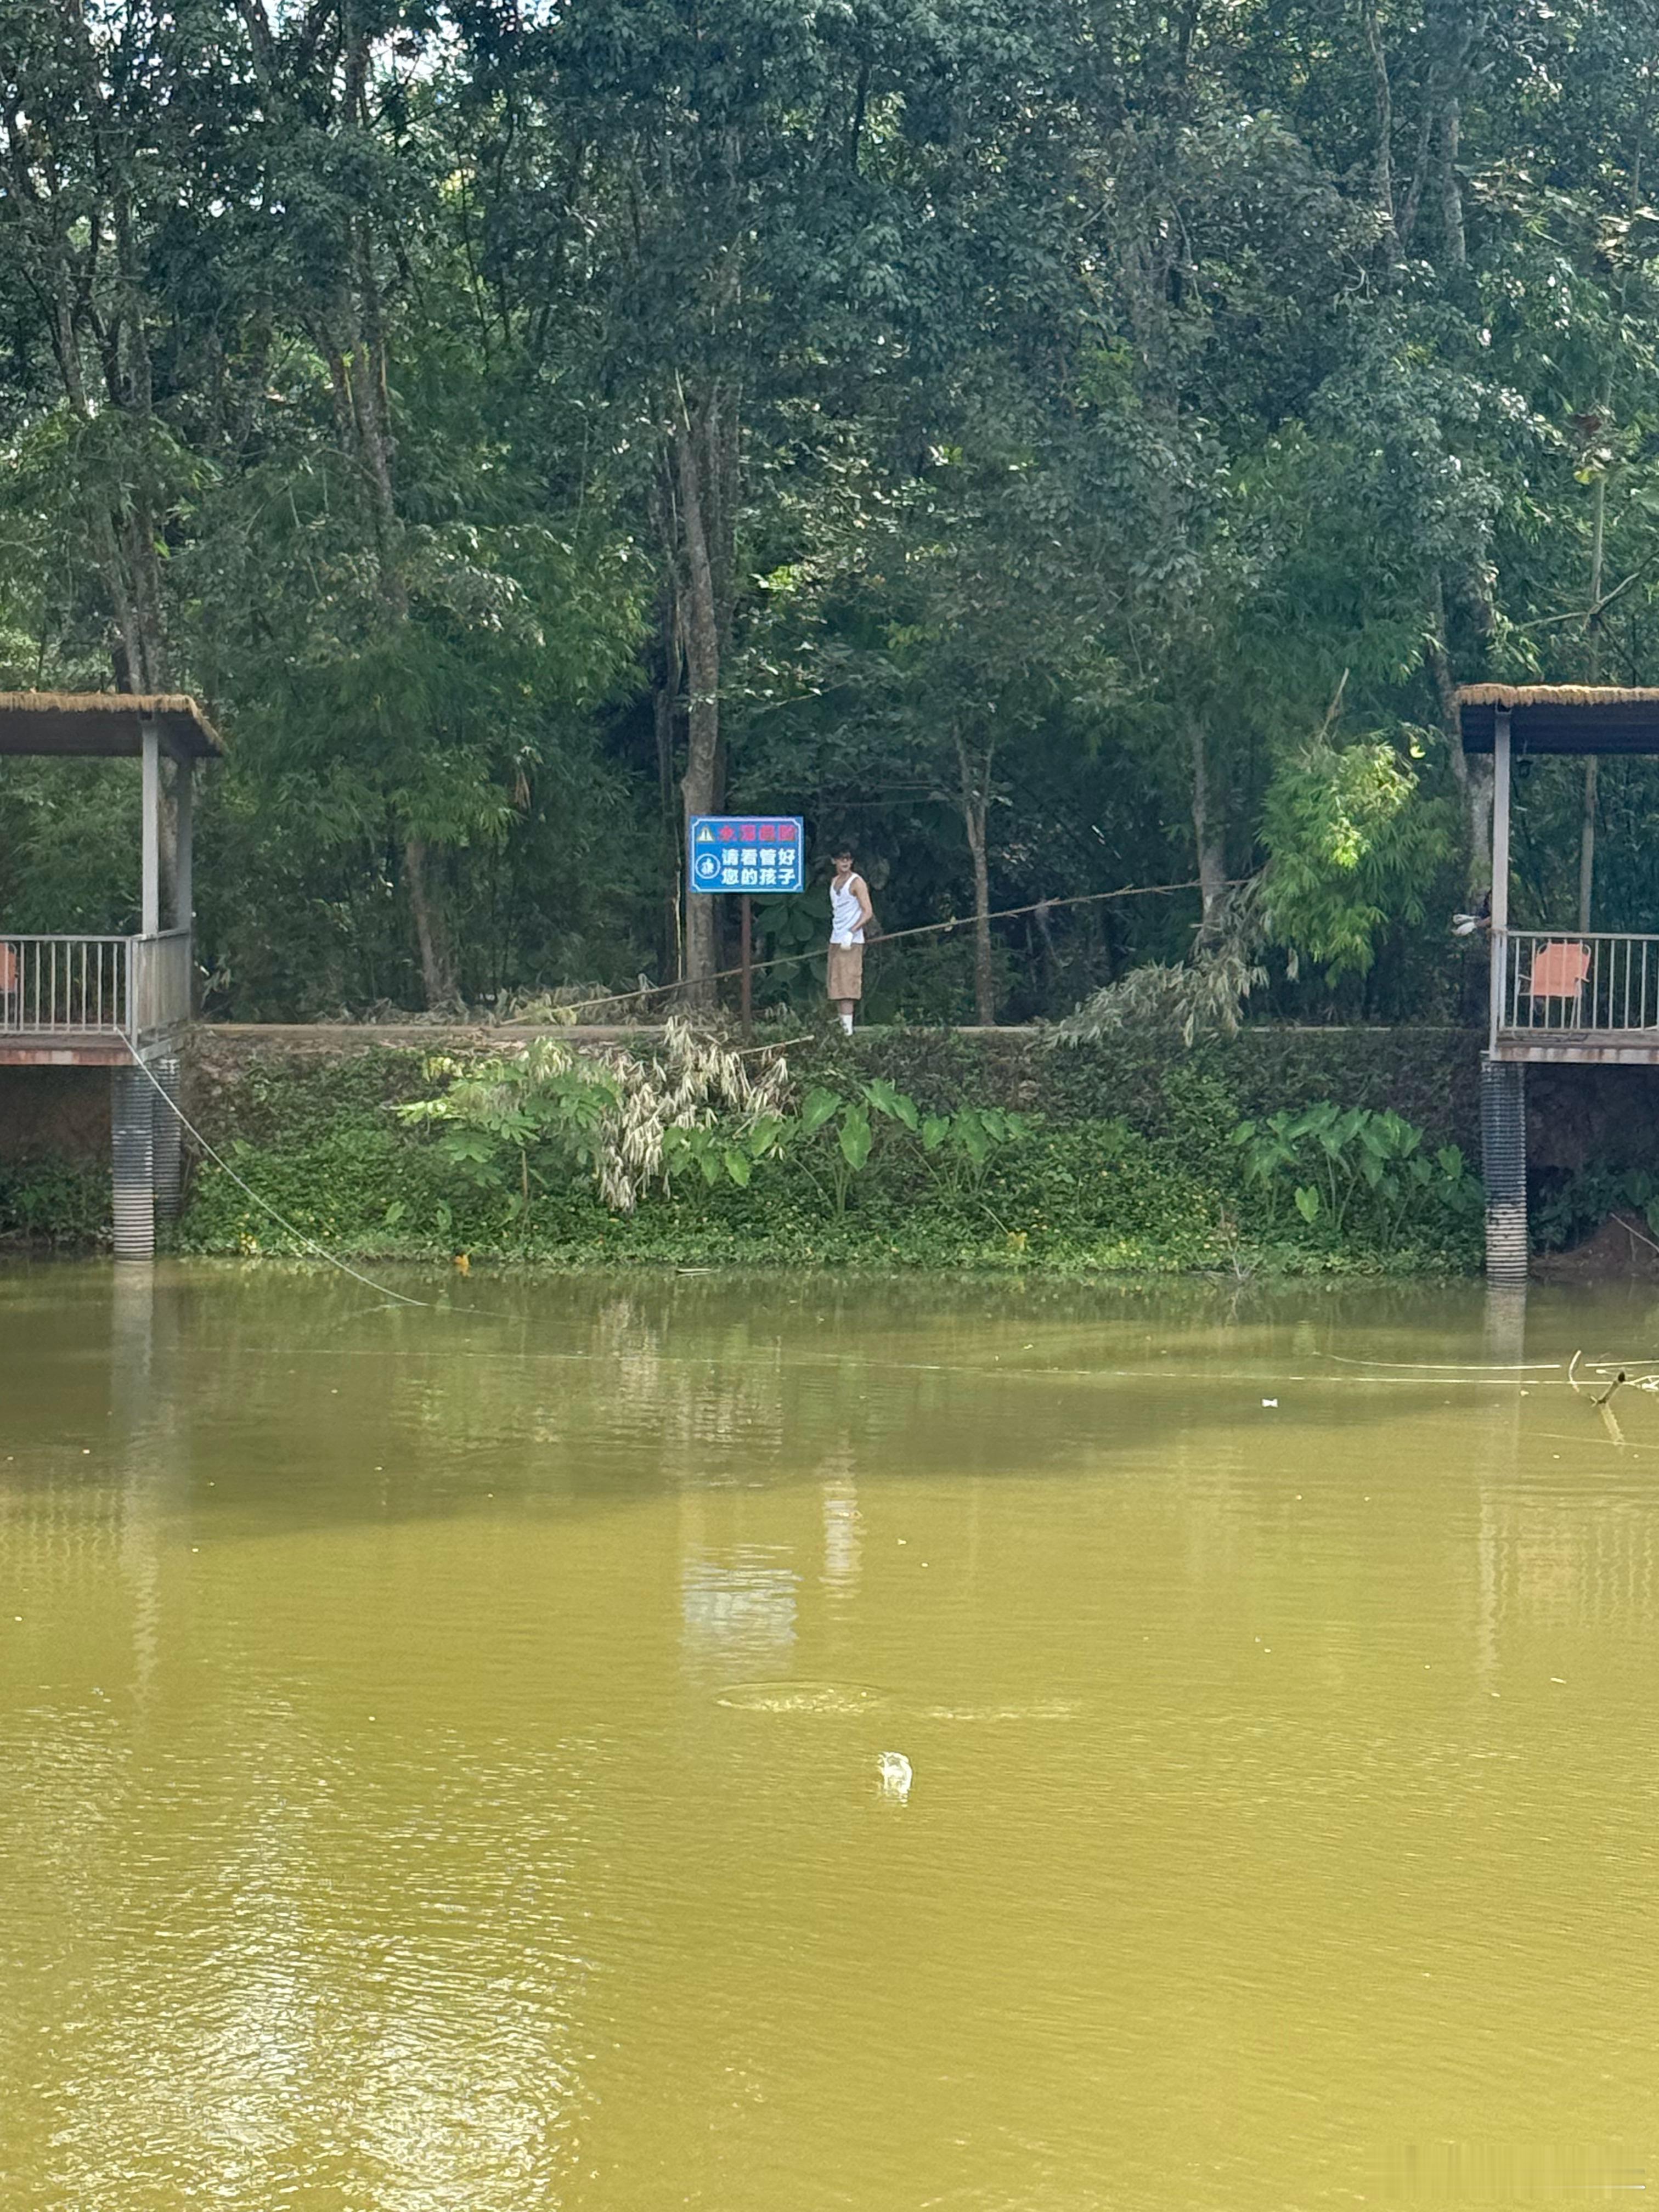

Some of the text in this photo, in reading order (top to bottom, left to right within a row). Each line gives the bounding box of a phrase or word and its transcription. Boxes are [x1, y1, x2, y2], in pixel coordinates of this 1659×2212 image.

[722, 848, 795, 866] 请看管好
[721, 868, 795, 885] 您的孩子
